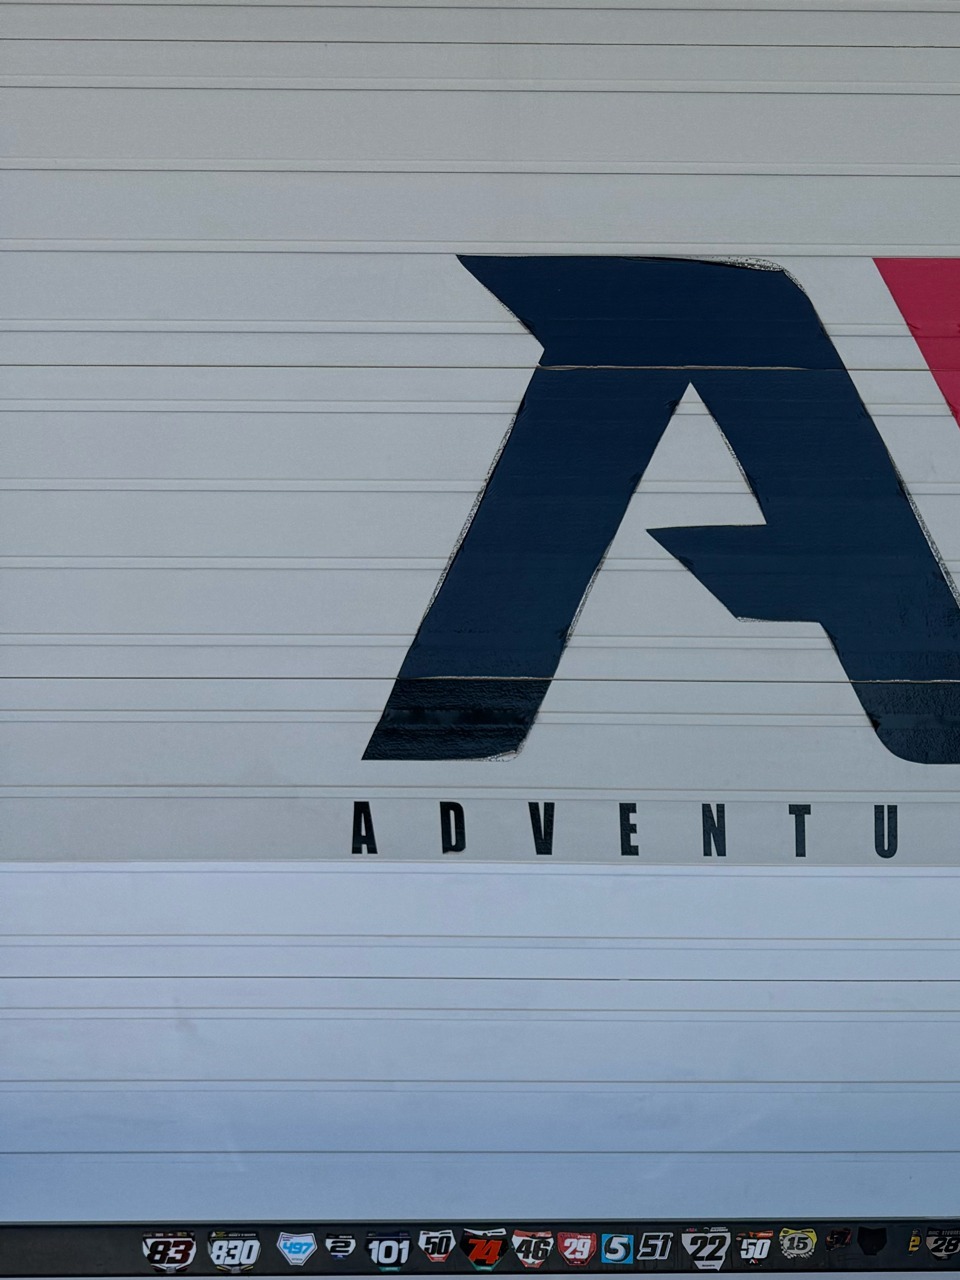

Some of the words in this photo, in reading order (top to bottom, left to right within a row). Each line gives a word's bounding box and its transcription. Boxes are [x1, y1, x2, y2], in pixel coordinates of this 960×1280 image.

[148, 1240, 193, 1264] 83
[210, 1239, 260, 1265] 830
[282, 1241, 312, 1254] 497
[368, 1240, 410, 1264] 101
[424, 1235, 451, 1255] 50
[468, 1239, 502, 1264] 74
[515, 1239, 550, 1261] 46
[563, 1238, 592, 1259] 29
[606, 1237, 629, 1260] 5
[637, 1232, 673, 1260] 51
[690, 1235, 727, 1261] 22
[740, 1239, 771, 1259] 50
[786, 1236, 809, 1250] 15
[932, 1237, 960, 1253] 28
